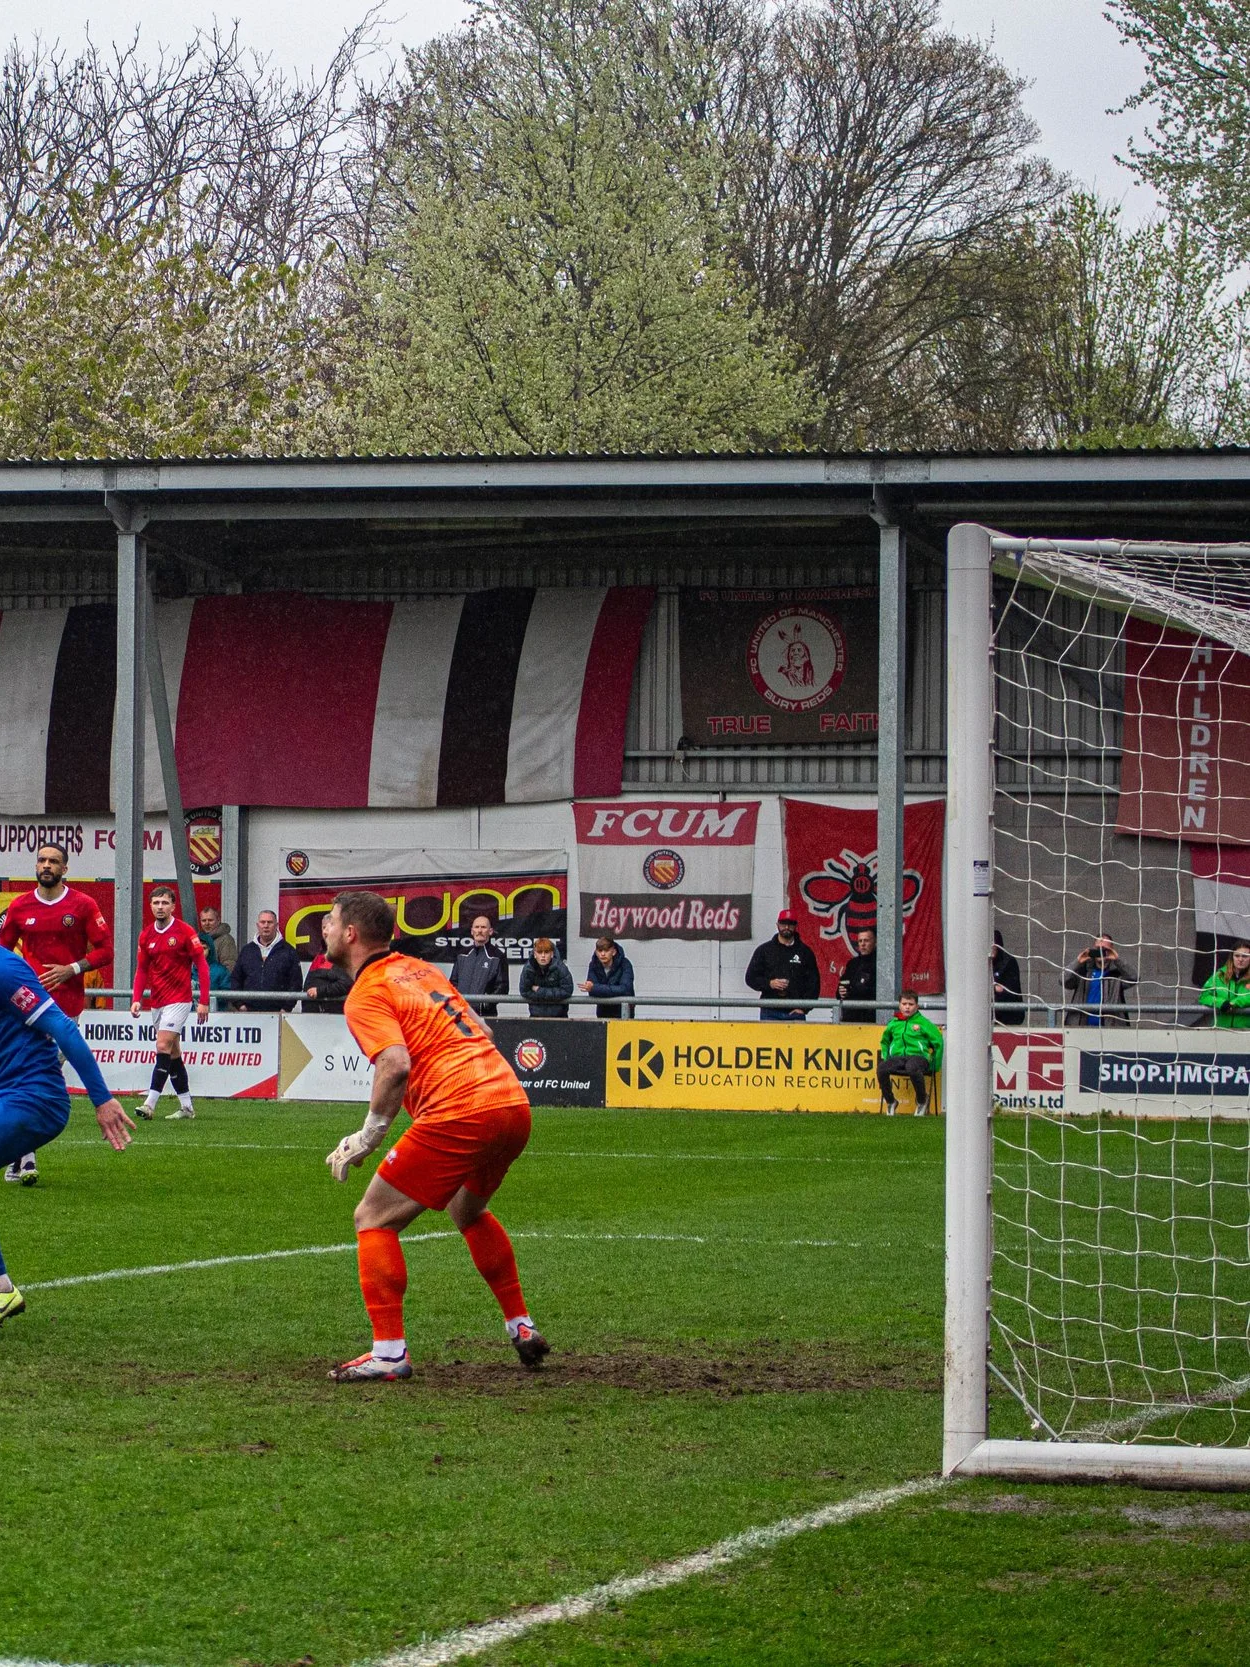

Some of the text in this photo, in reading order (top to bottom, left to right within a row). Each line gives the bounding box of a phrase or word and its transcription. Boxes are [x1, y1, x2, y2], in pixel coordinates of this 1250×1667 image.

[750, 615, 777, 654] UNITED
[779, 607, 795, 617] OF
[798, 607, 845, 672] MANCHESTER
[763, 687, 833, 711] BURY REDS
[707, 714, 772, 735] TRUE
[1183, 642, 1212, 829] HILDREN
[587, 808, 748, 838] FCUM
[591, 897, 740, 935] Heywood Reds
[85, 1024, 134, 1041] HOMES
[191, 1026, 231, 1043] WEST
[236, 1026, 262, 1044] LTD
[118, 1050, 157, 1064] FUTUR
[182, 1052, 197, 1065] TH
[201, 1052, 215, 1066] FC
[218, 1052, 262, 1067] UNITED
[674, 1045, 882, 1072] HOLDEN KNIG
[674, 1073, 910, 1090] EDUCATION RECRUITMNT
[1098, 1063, 1250, 1084] SHOP.HMGPA
[533, 1079, 543, 1088] of
[545, 1079, 558, 1088] FC
[560, 1080, 591, 1090] United
[1040, 1093, 1064, 1109] Ltd
